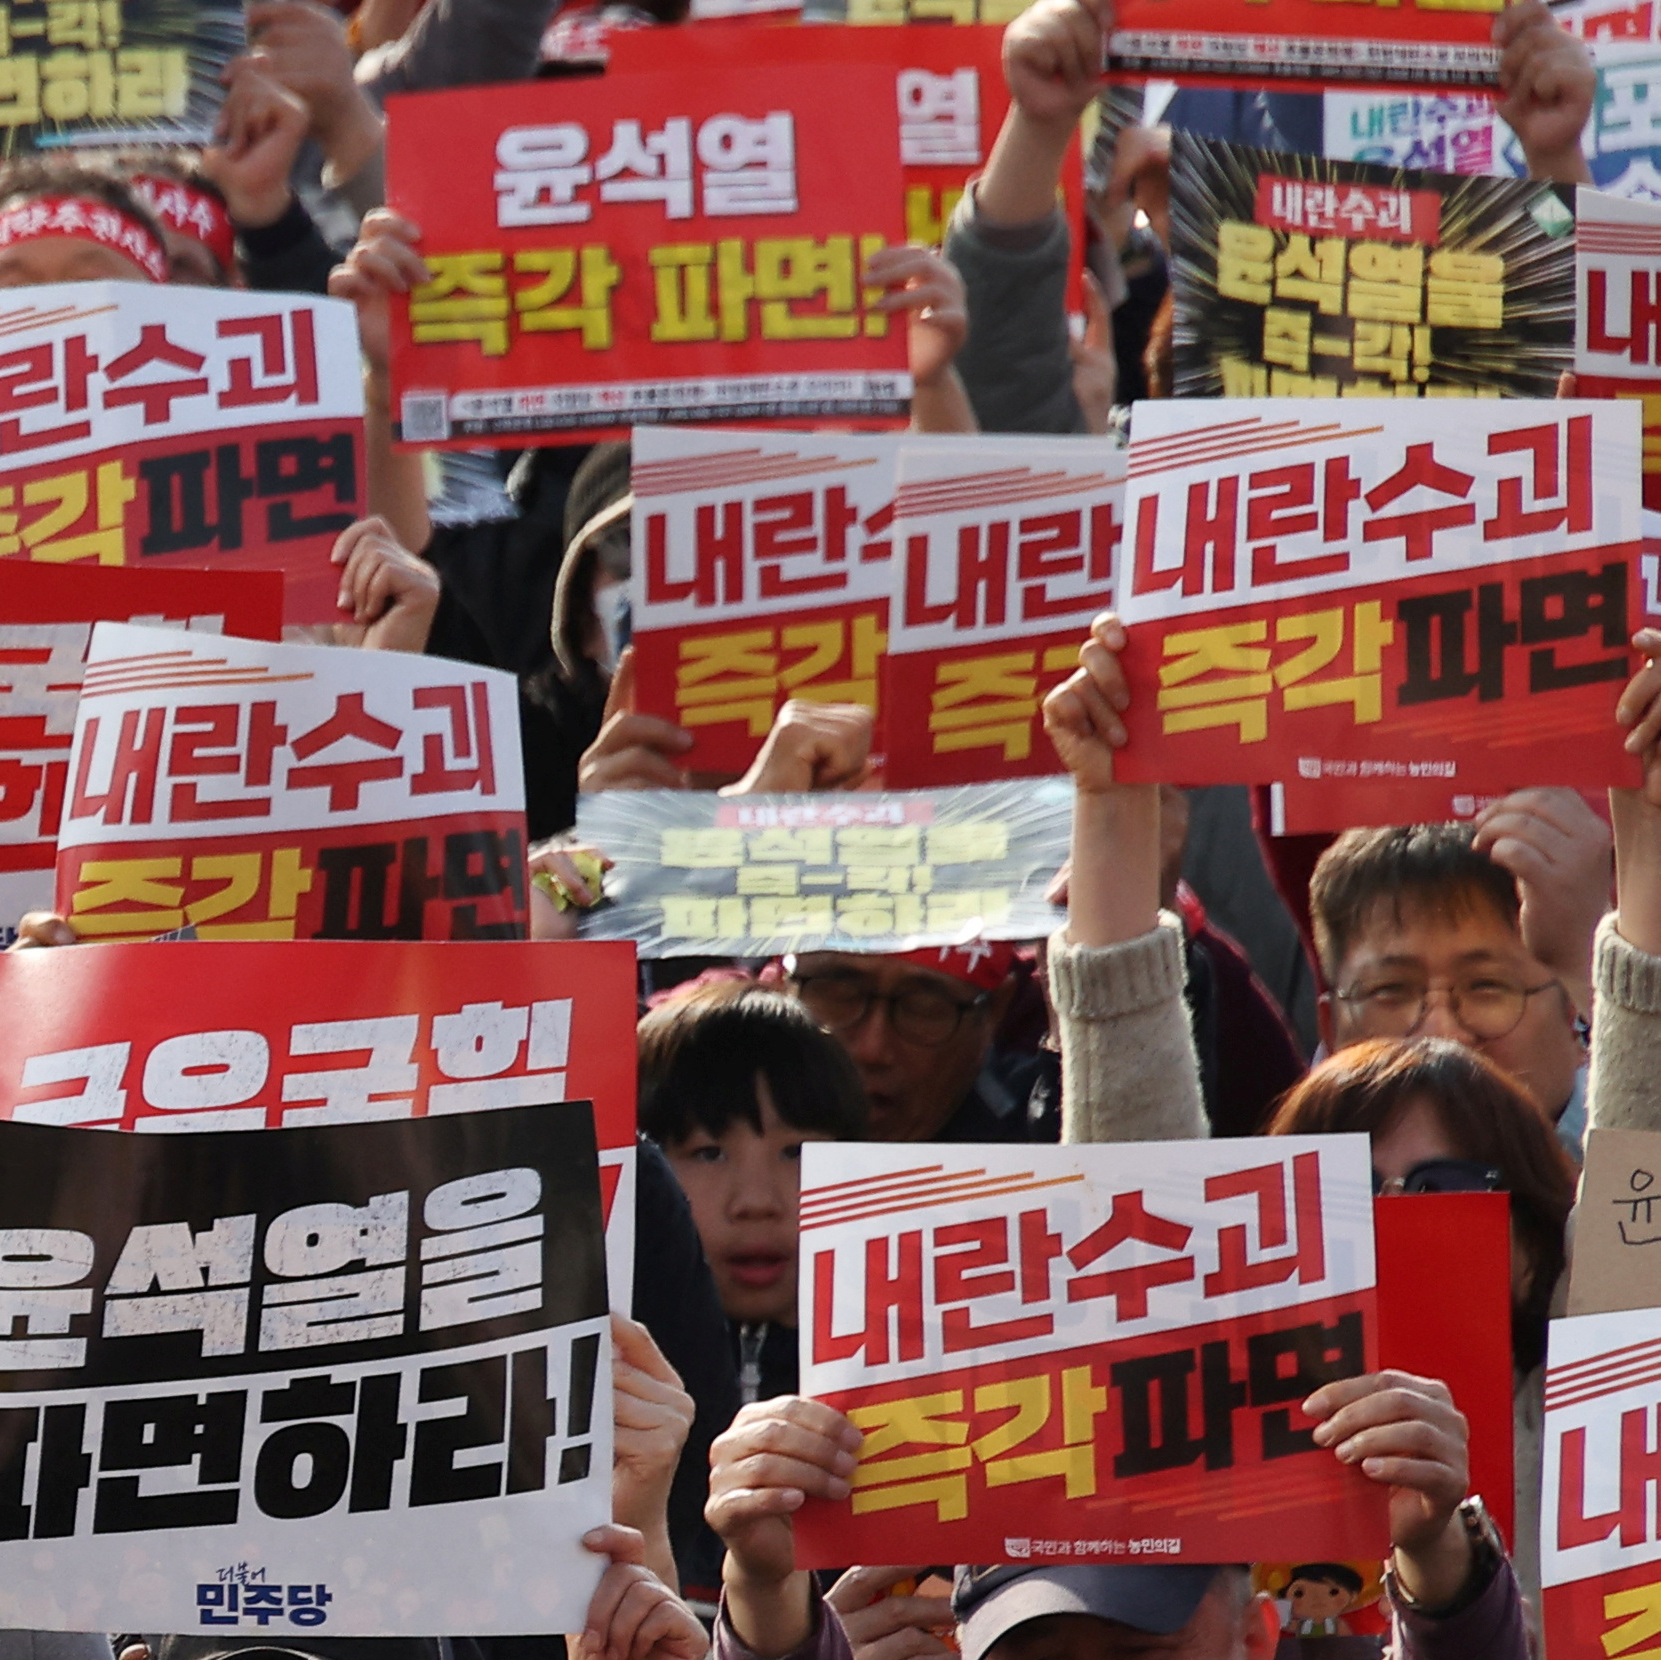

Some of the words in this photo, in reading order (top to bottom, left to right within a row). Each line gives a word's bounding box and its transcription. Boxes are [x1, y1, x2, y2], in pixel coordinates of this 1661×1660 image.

[493, 110, 800, 229] 윤석열
[1272, 182, 1413, 235] 내란수괴
[408, 242, 622, 357] 즉각
[1217, 219, 1505, 329] 윤석열을
[1262, 308, 1432, 384] 즉-각!
[1131, 413, 1593, 599] 내란수괴
[1158, 602, 1397, 743] 즉각
[68, 679, 496, 826] 내란수괴
[811, 1151, 1327, 1368] 내란수괴
[195, 1582, 334, 1627] 민주당
